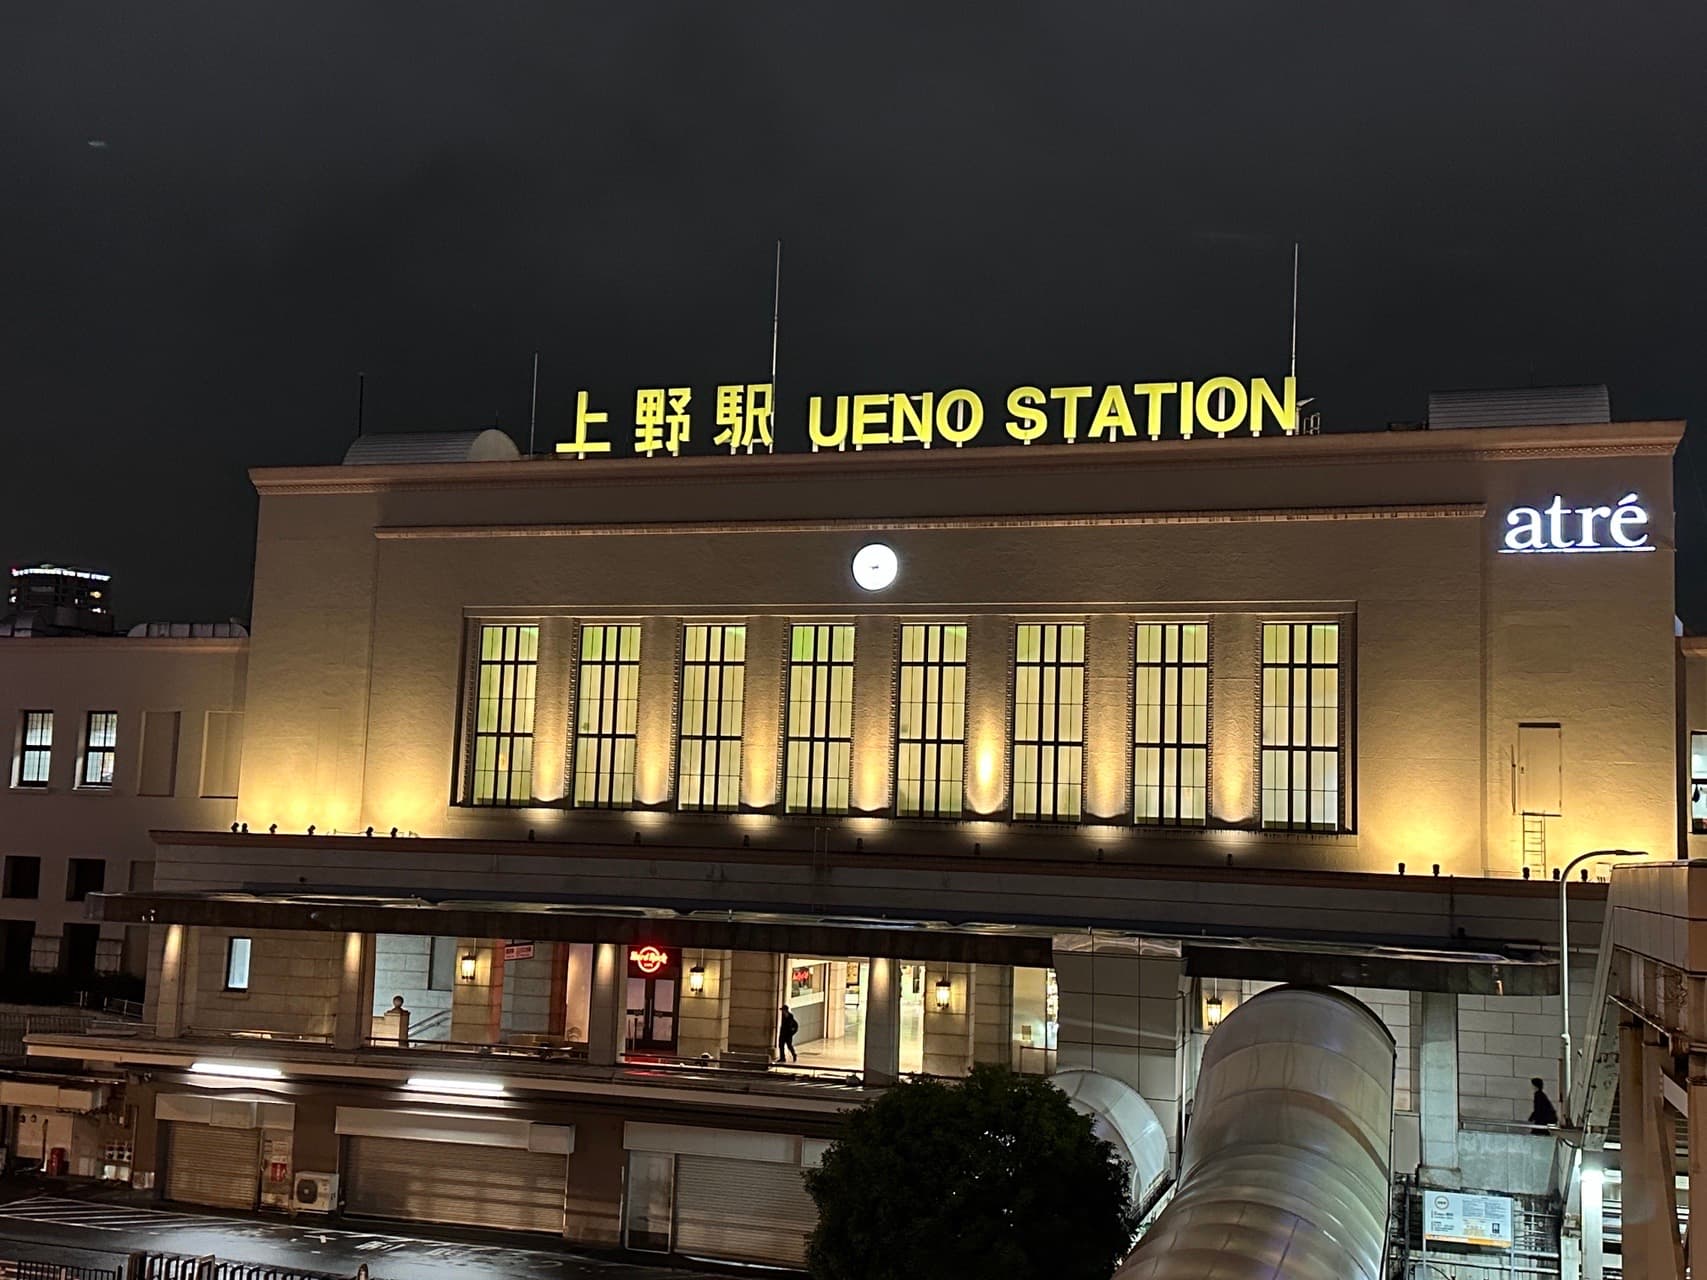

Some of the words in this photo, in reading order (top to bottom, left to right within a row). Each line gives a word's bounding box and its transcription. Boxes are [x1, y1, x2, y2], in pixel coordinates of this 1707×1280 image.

[555, 383, 773, 453] 上野駅
[808, 389, 984, 447] UENO
[1006, 376, 1298, 443] STATION
[1504, 493, 1649, 549] atré
